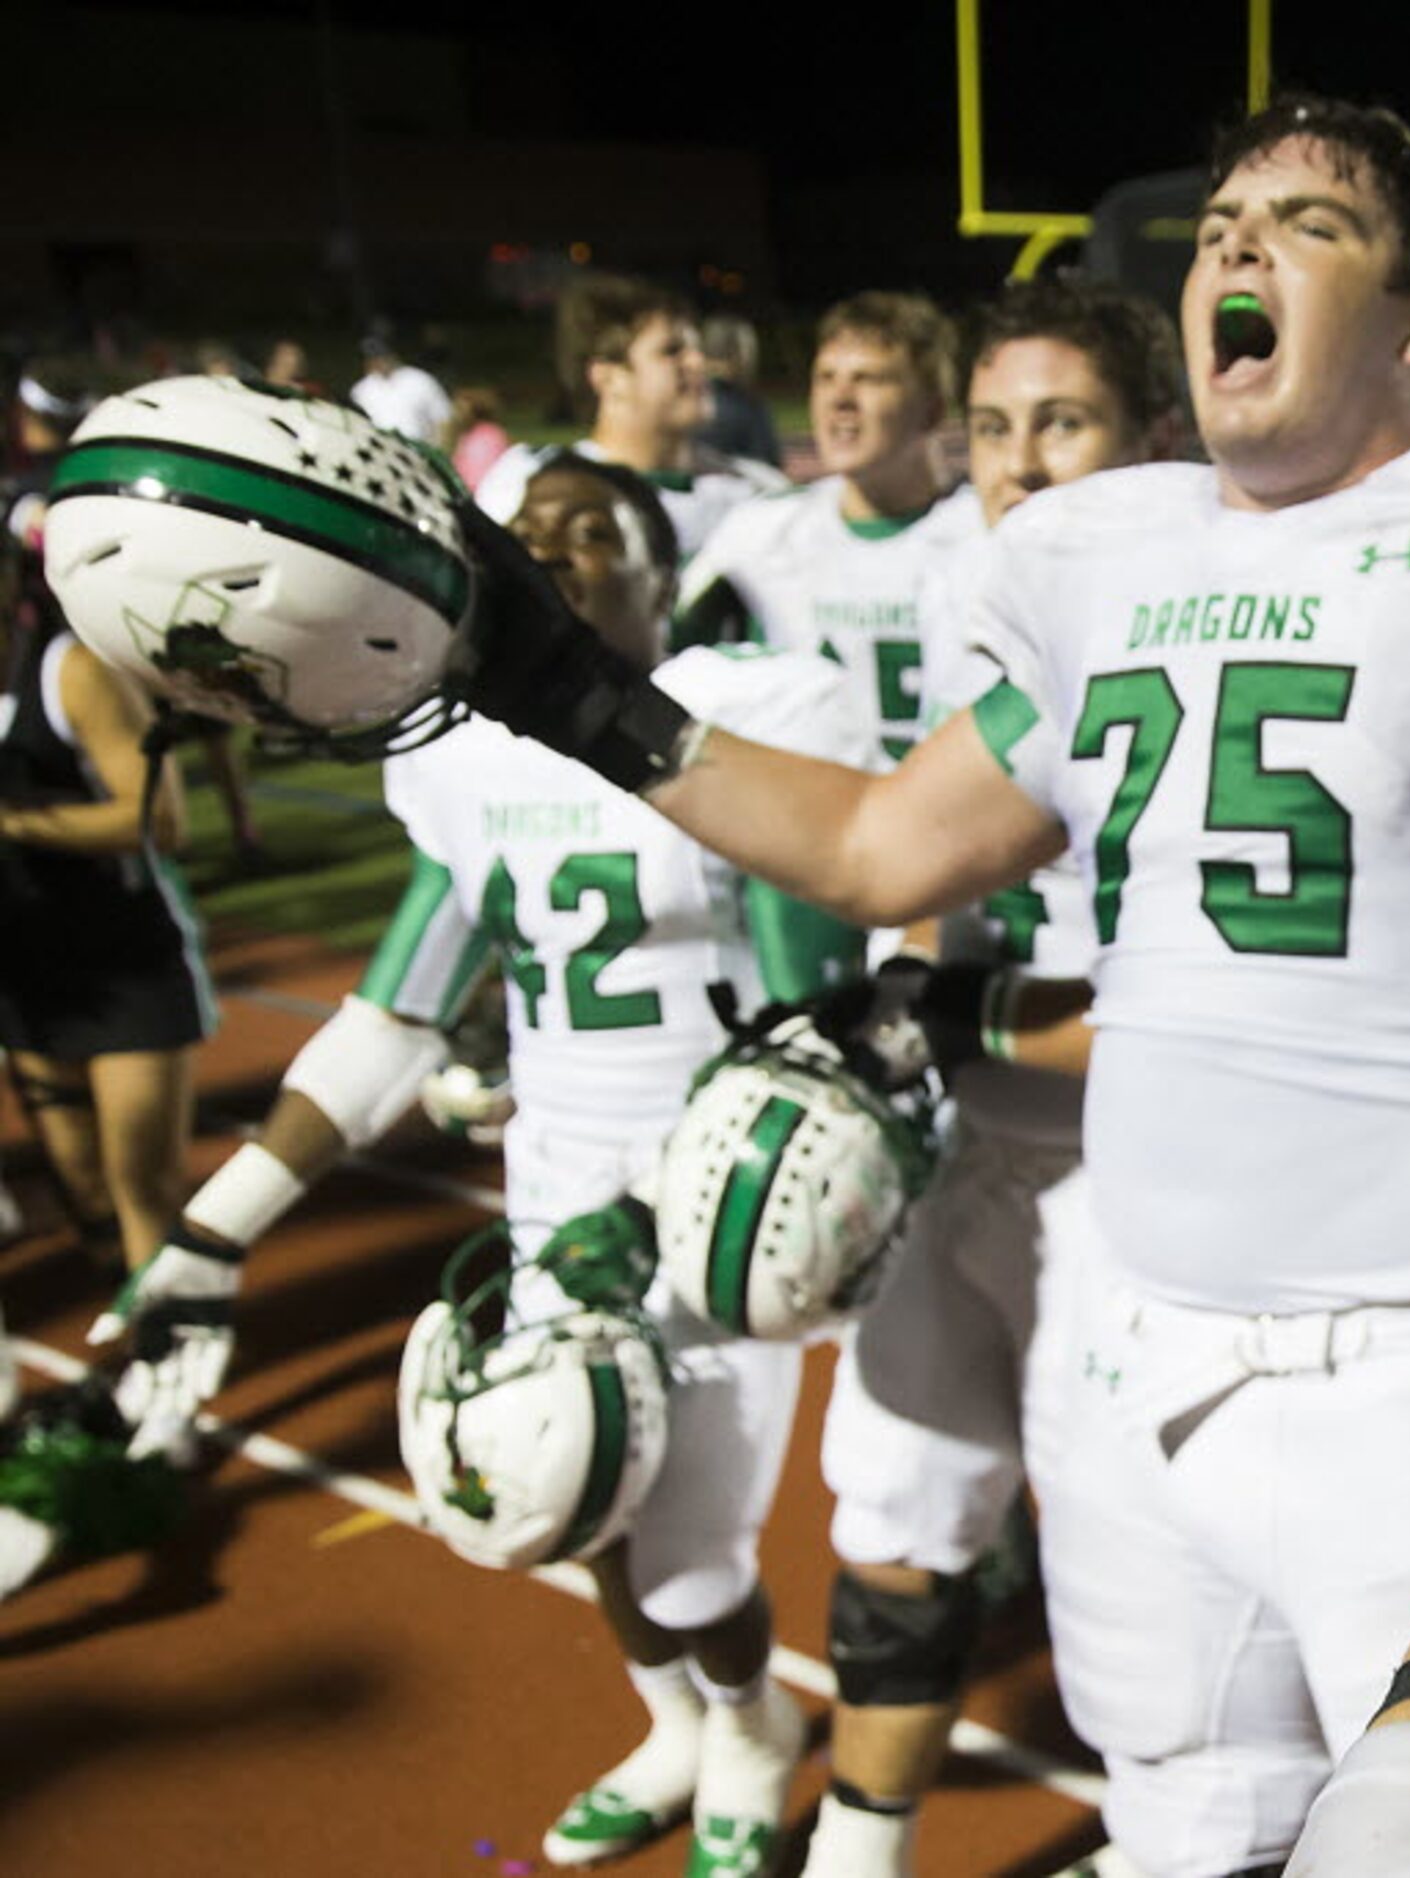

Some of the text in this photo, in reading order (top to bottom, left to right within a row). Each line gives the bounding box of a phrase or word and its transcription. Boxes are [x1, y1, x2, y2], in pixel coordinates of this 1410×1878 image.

[817, 635, 923, 763] 5
[1127, 594, 1322, 651] DRAGONS
[1071, 660, 1357, 958] 75
[478, 853, 663, 1032] 42
